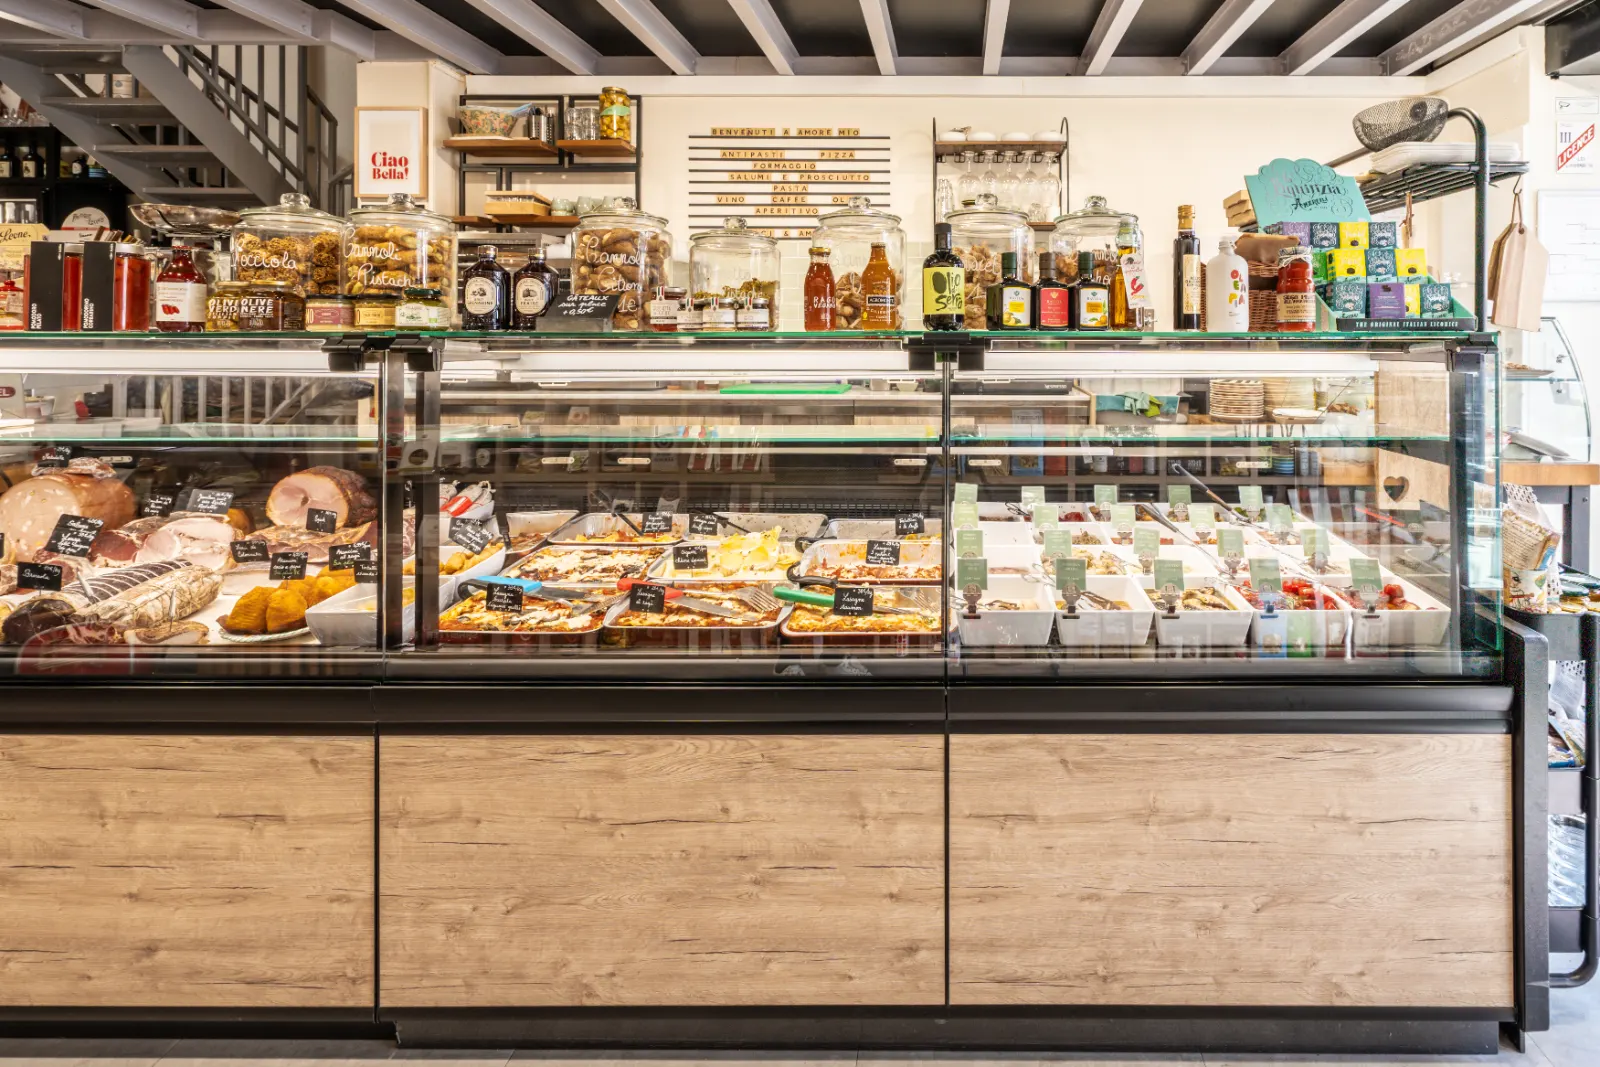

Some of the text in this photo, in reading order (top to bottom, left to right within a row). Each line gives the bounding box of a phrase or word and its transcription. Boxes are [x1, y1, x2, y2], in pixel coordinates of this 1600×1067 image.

[1558, 125, 1594, 168] LICENCE
[371, 152, 409, 167] Ciao
[373, 167, 409, 180] Bella!
[343, 227, 402, 260] Cannoli
[209, 305, 239, 313] VERD
[240, 305, 274, 314] NERE
